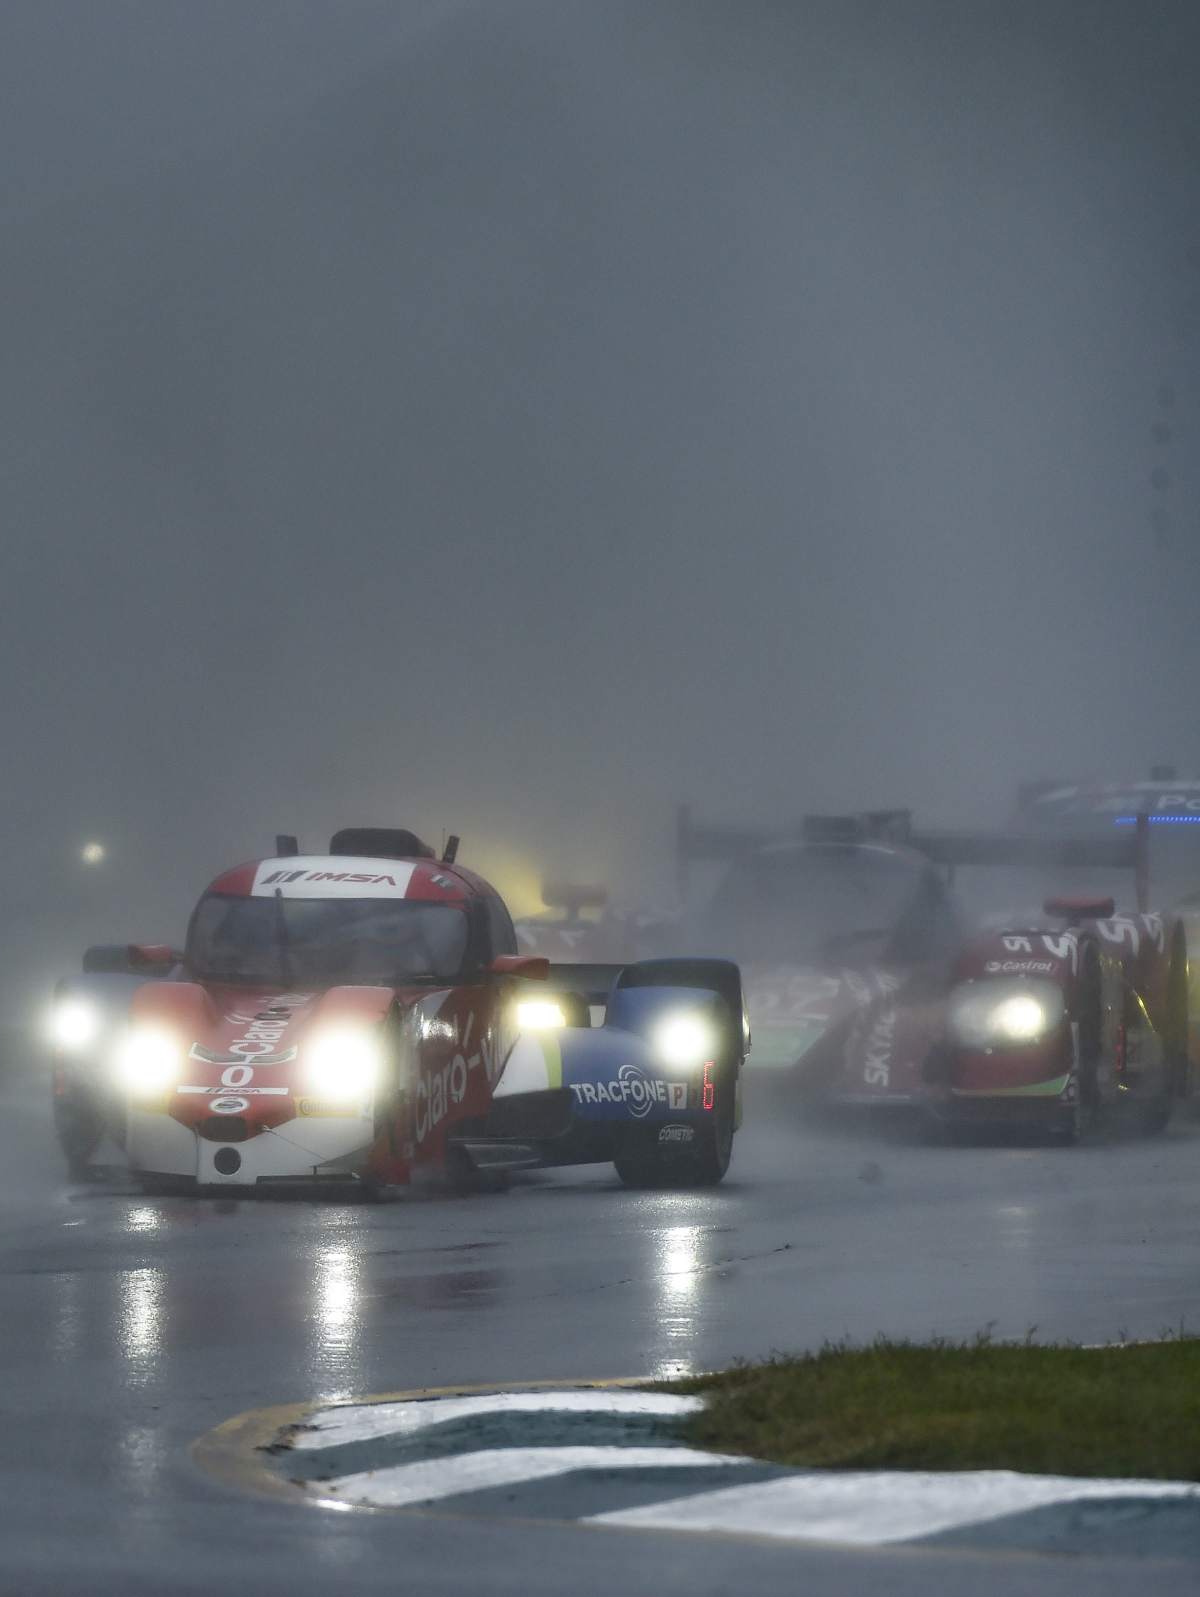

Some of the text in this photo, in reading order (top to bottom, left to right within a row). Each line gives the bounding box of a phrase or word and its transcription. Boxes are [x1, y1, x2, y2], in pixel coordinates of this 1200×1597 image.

[306, 872, 396, 886] IMSA
[1002, 960, 1052, 972] Castrol
[229, 1020, 289, 1055] Claro
[569, 1080, 666, 1104] TRACFONE
